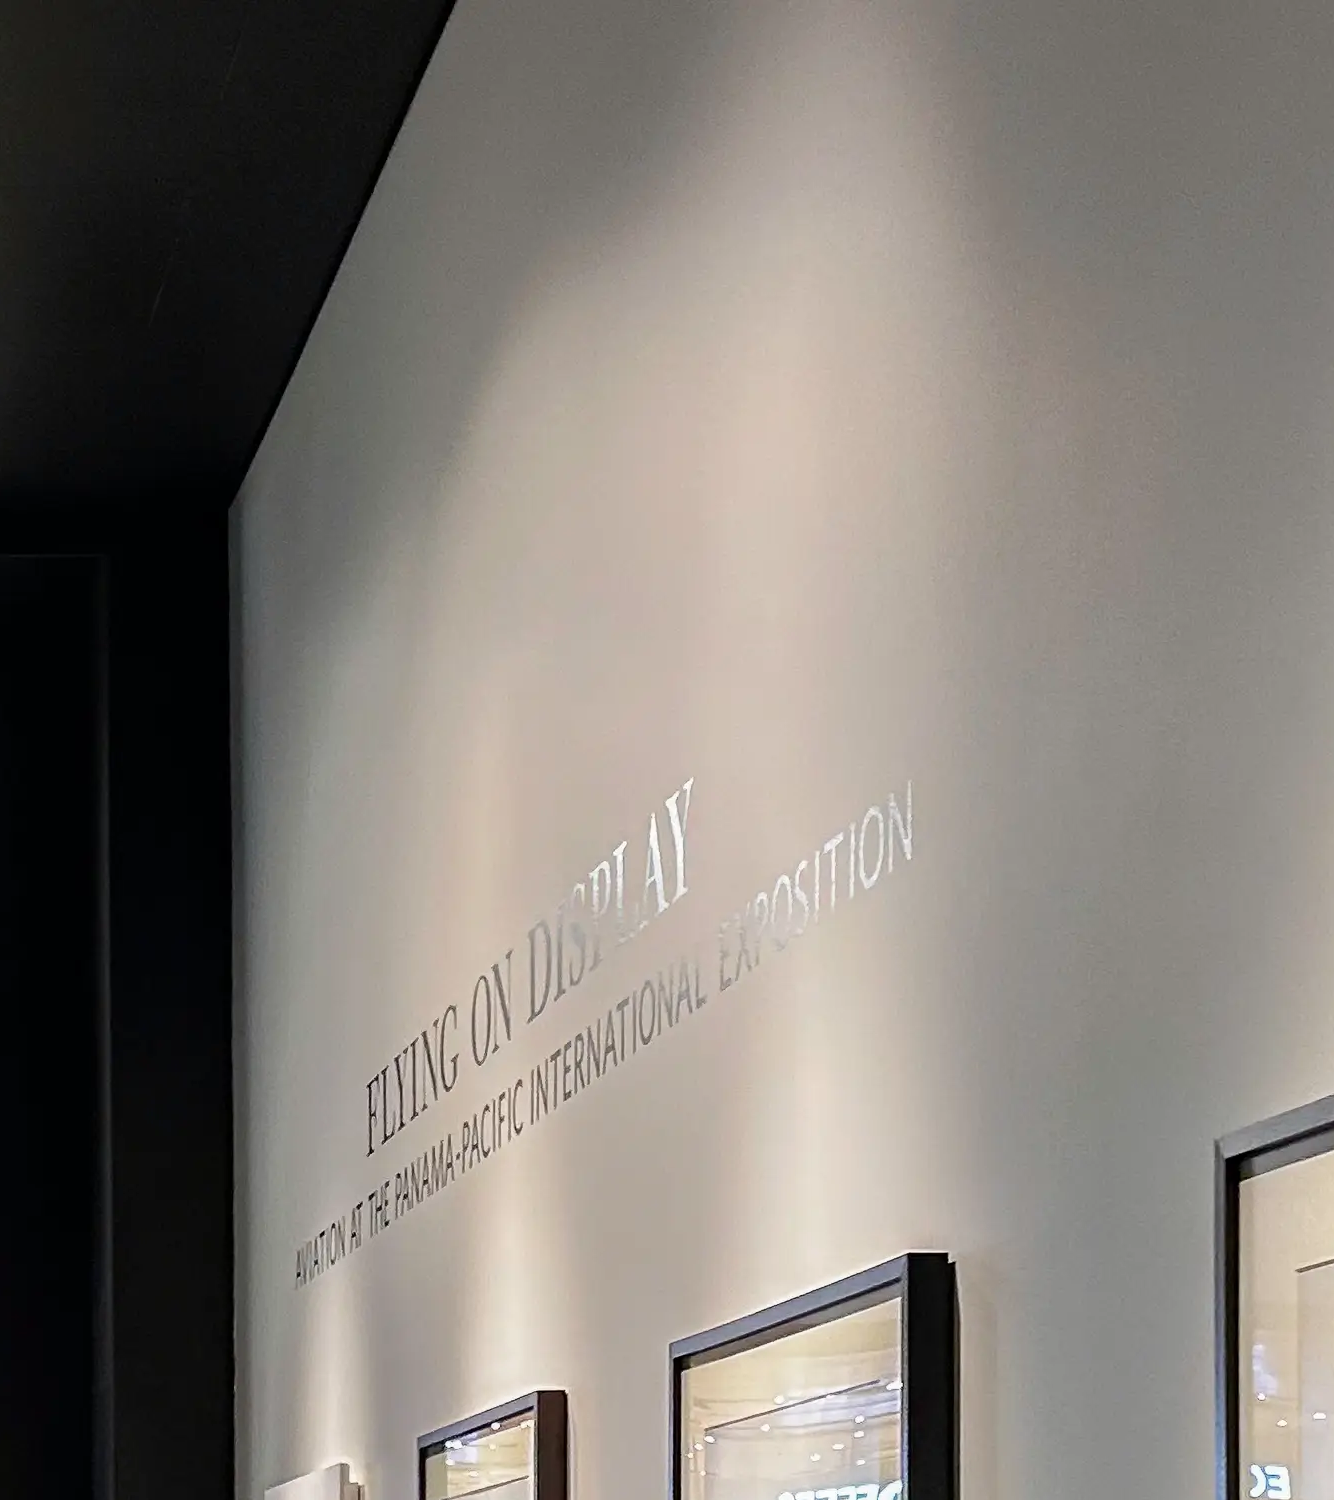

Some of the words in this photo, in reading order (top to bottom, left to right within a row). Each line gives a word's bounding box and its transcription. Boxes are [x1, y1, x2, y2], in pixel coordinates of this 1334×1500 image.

[294, 1215, 346, 1290] AVIATION
[349, 1201, 364, 1254] AT
[368, 1180, 390, 1238] THE
[394, 1078, 524, 1220] PANAMA-PACIFIC
[530, 955, 708, 1126] INTERNATIONAL
[718, 779, 913, 993] EXPOSITION
[365, 1004, 460, 1158] FLYING
[471, 949, 514, 1067] ON
[525, 776, 695, 1025] DISPLAY
